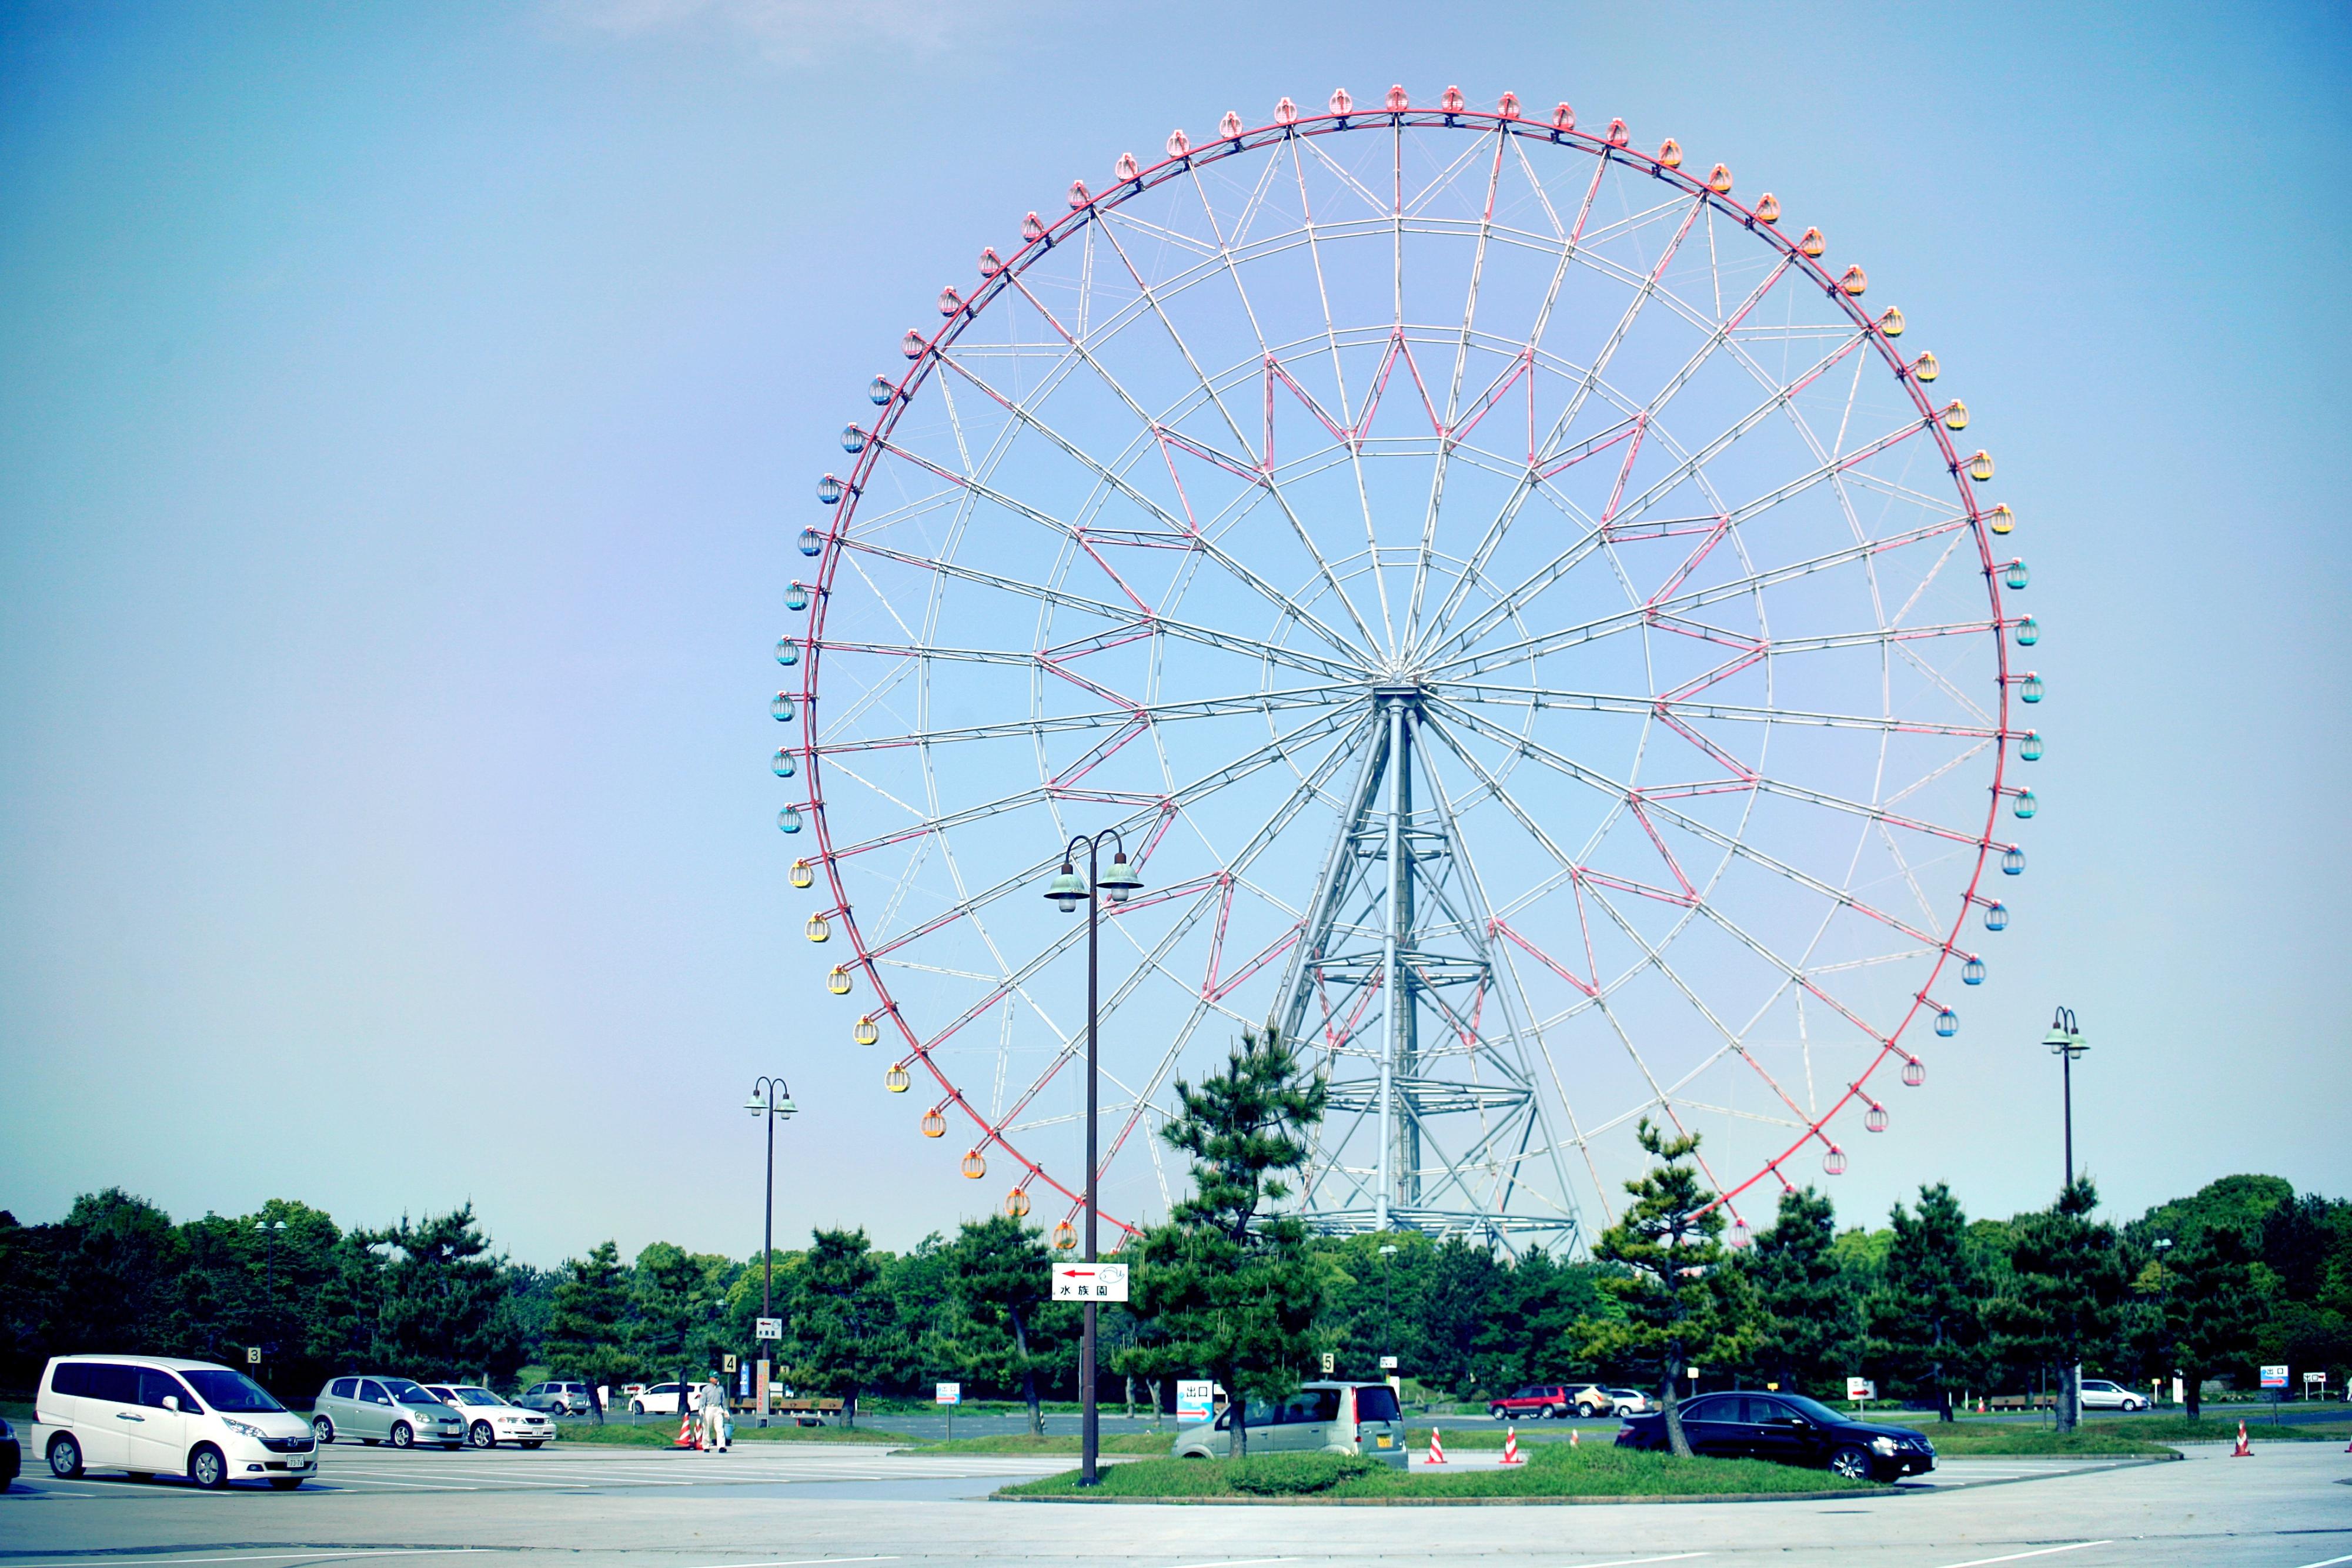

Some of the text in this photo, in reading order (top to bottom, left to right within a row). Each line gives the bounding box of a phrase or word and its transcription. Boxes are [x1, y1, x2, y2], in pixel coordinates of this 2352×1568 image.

[1060, 1285, 1107, 1296] 水族園
[250, 1349, 258, 1362] 3
[727, 1357, 734, 1370] 4
[1325, 1356, 1331, 1369] 5
[1187, 1386, 1208, 1397] 出口
